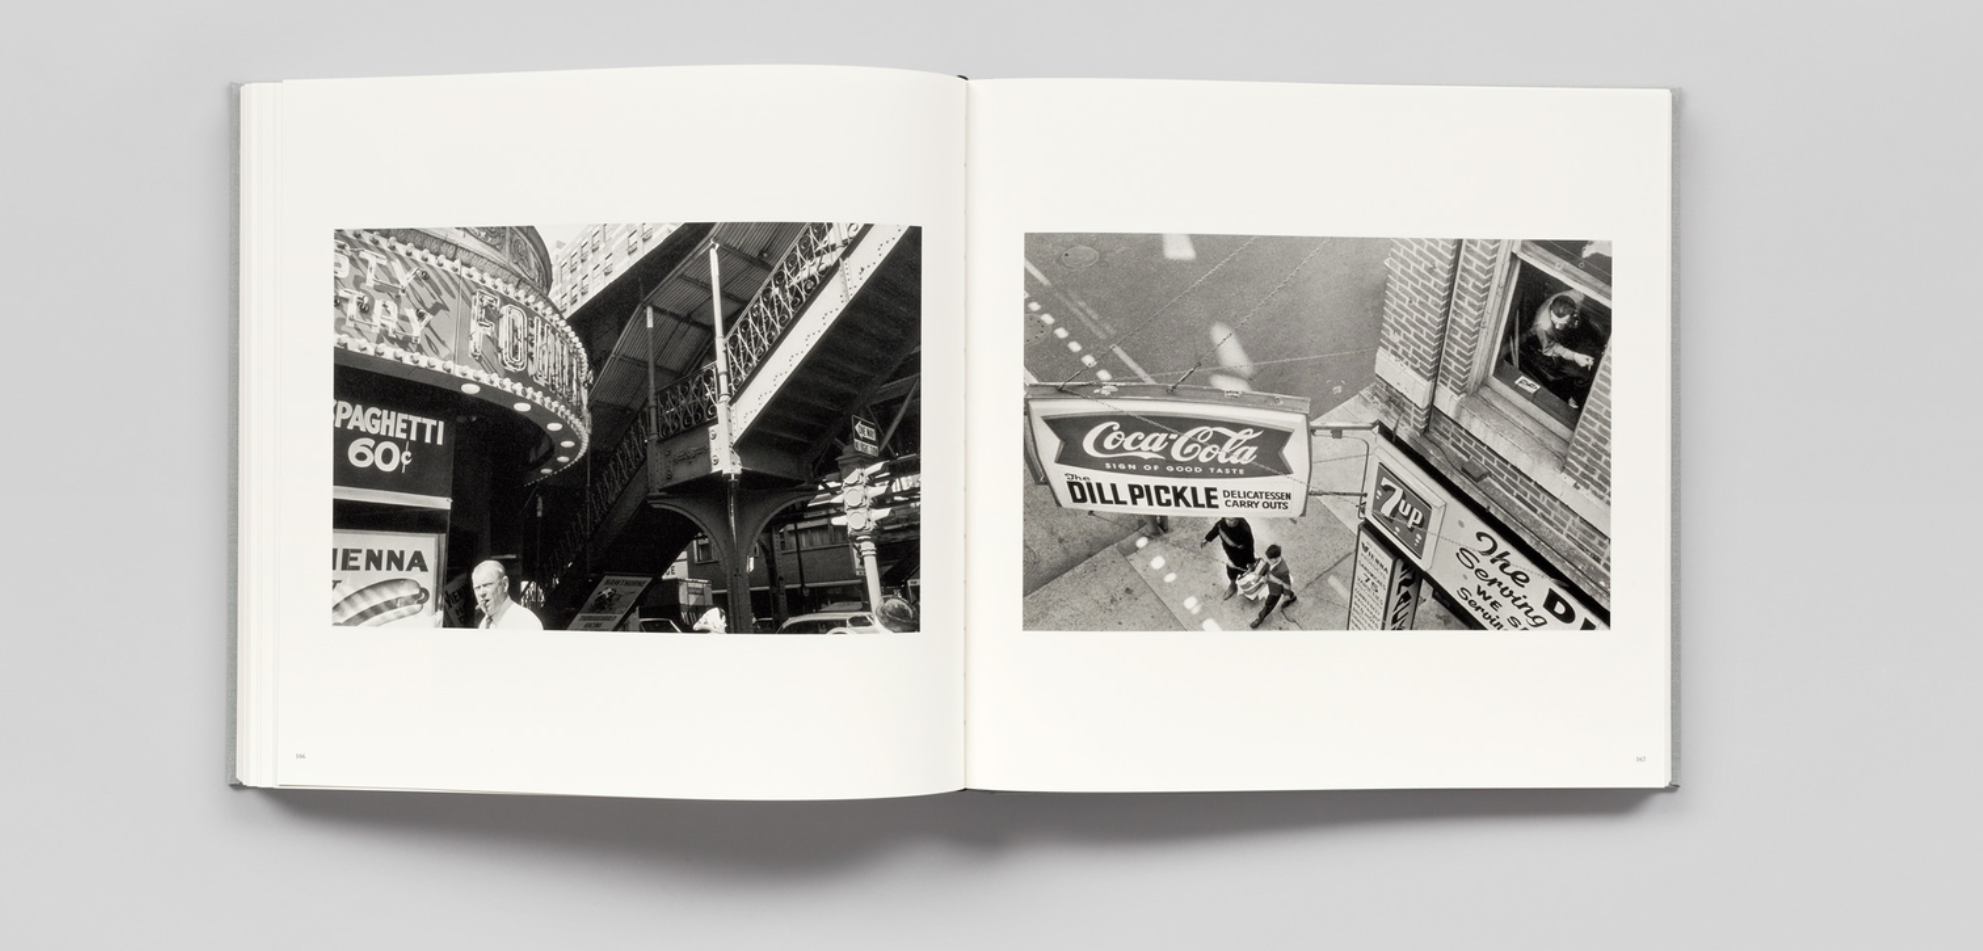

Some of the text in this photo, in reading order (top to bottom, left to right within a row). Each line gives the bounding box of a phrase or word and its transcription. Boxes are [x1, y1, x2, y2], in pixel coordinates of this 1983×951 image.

[333, 399, 444, 445] PAGHETTI
[348, 437, 412, 474] 60¢
[1083, 421, 1264, 464] Coca-Cola
[1065, 473, 1091, 482] The
[1105, 462, 1136, 471] SIGN
[1166, 465, 1202, 474] GOOD
[1209, 467, 1245, 475] TASTE
[1066, 481, 1219, 508] DILL PICKLE
[1223, 489, 1291, 501] DELICATESSEN
[1225, 500, 1289, 510] CARRY OUTS
[1475, 531, 1530, 588] The
[1456, 547, 1548, 628] Serving
[1476, 584, 1530, 630] WE S
[1457, 587, 1509, 630] Servin
